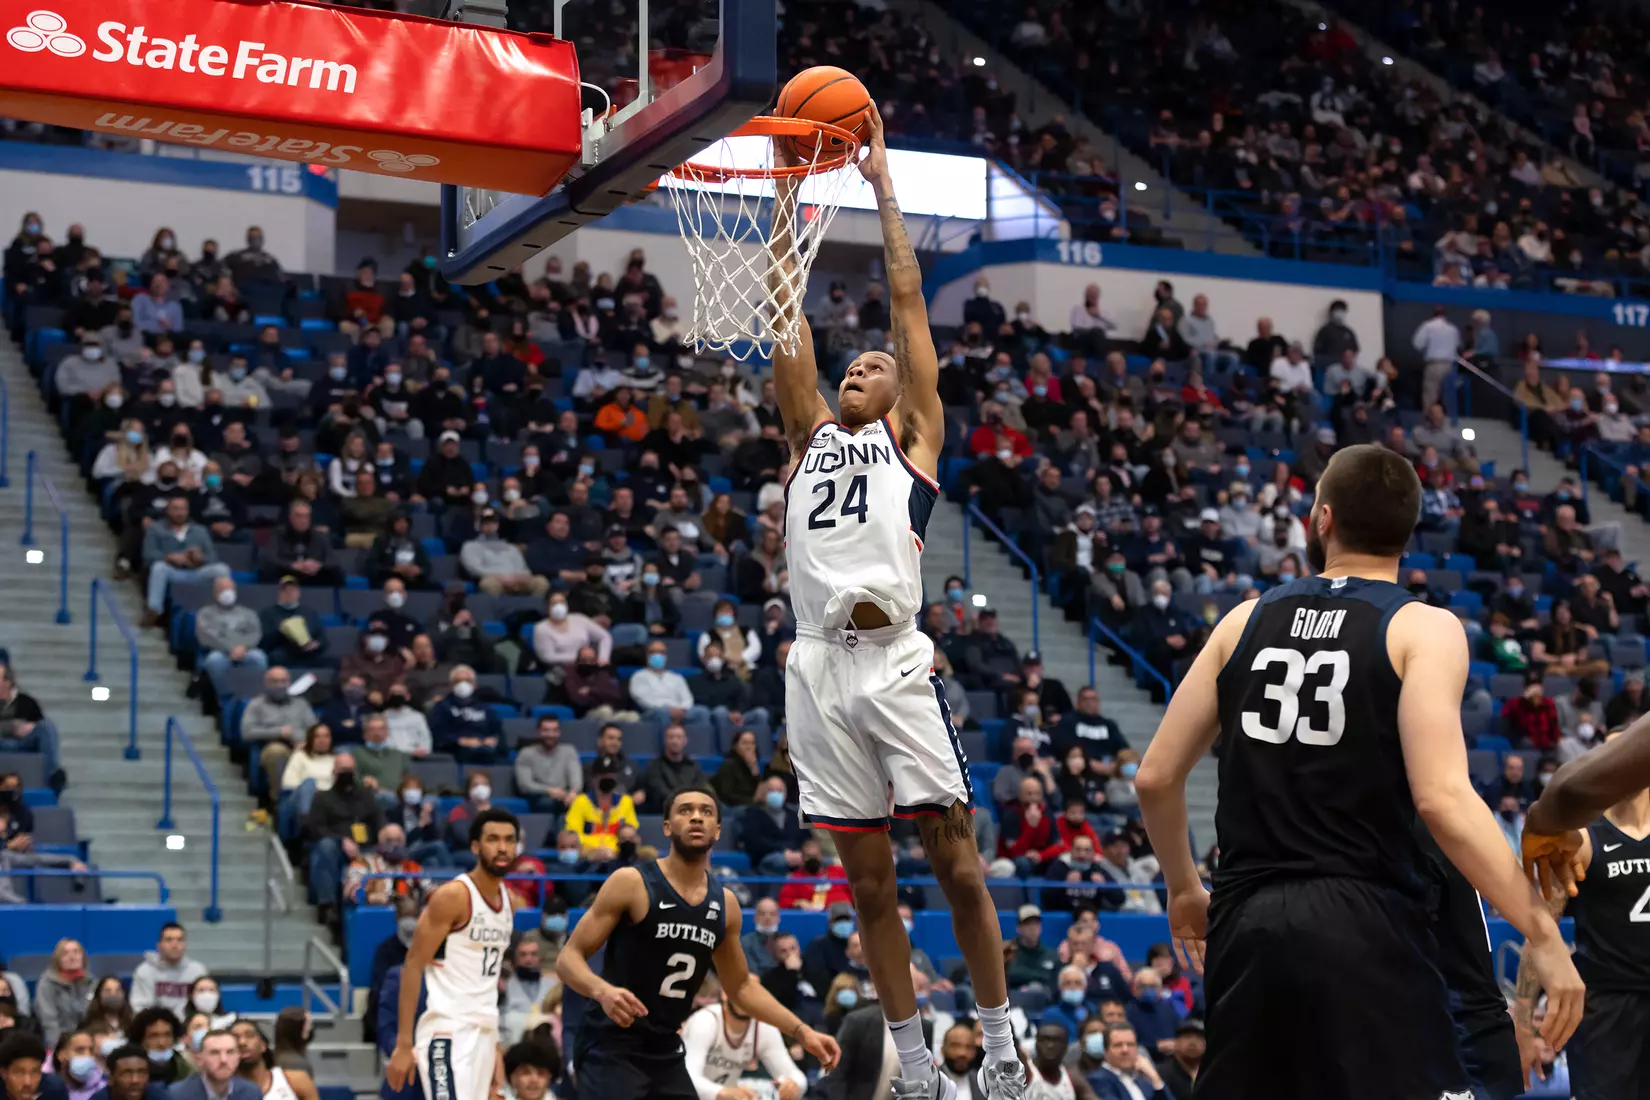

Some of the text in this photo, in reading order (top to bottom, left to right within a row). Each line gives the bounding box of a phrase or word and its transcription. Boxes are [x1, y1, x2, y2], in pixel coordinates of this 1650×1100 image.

[92, 21, 358, 94] State Farm
[246, 166, 303, 194] 115
[1056, 241, 1102, 266] 116
[1613, 303, 1650, 327] 117
[808, 474, 868, 531] 24
[1241, 647, 1350, 746] 33
[655, 922, 717, 950] BUTLER
[481, 946, 500, 978] 12
[659, 952, 697, 999] 2
